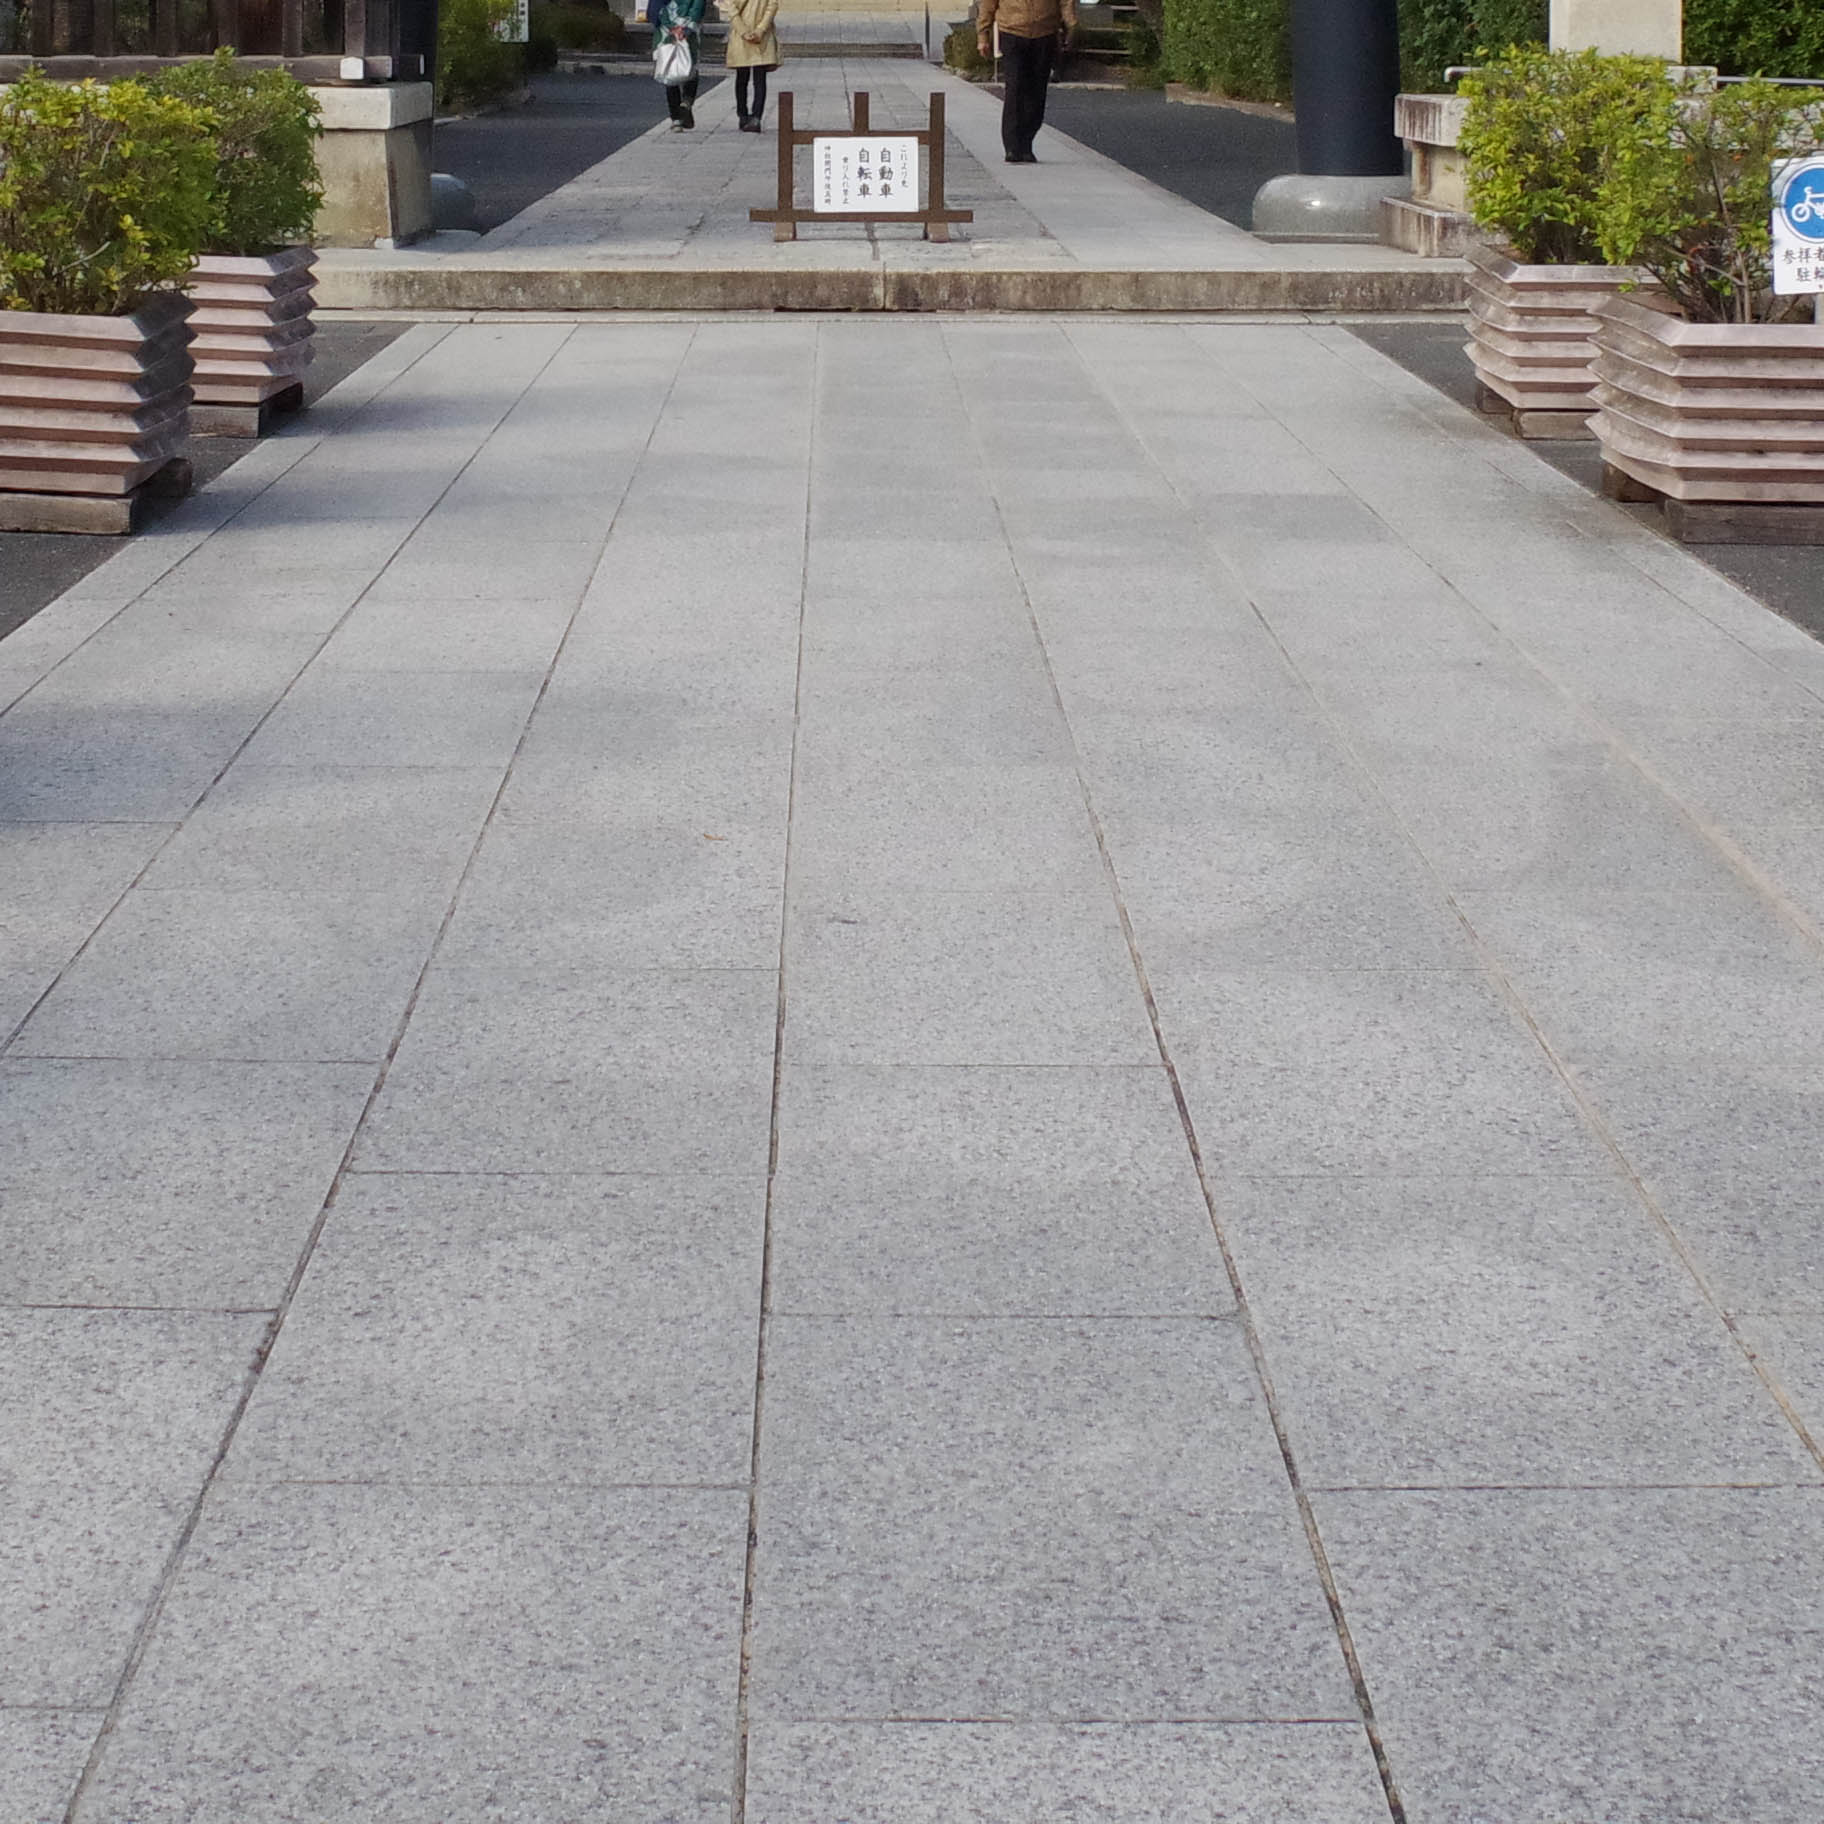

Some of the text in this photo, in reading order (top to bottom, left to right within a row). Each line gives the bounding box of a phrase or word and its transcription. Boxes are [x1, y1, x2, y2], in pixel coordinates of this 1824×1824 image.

[857, 146, 873, 199] 自転車
[878, 147, 894, 199] 自動車
